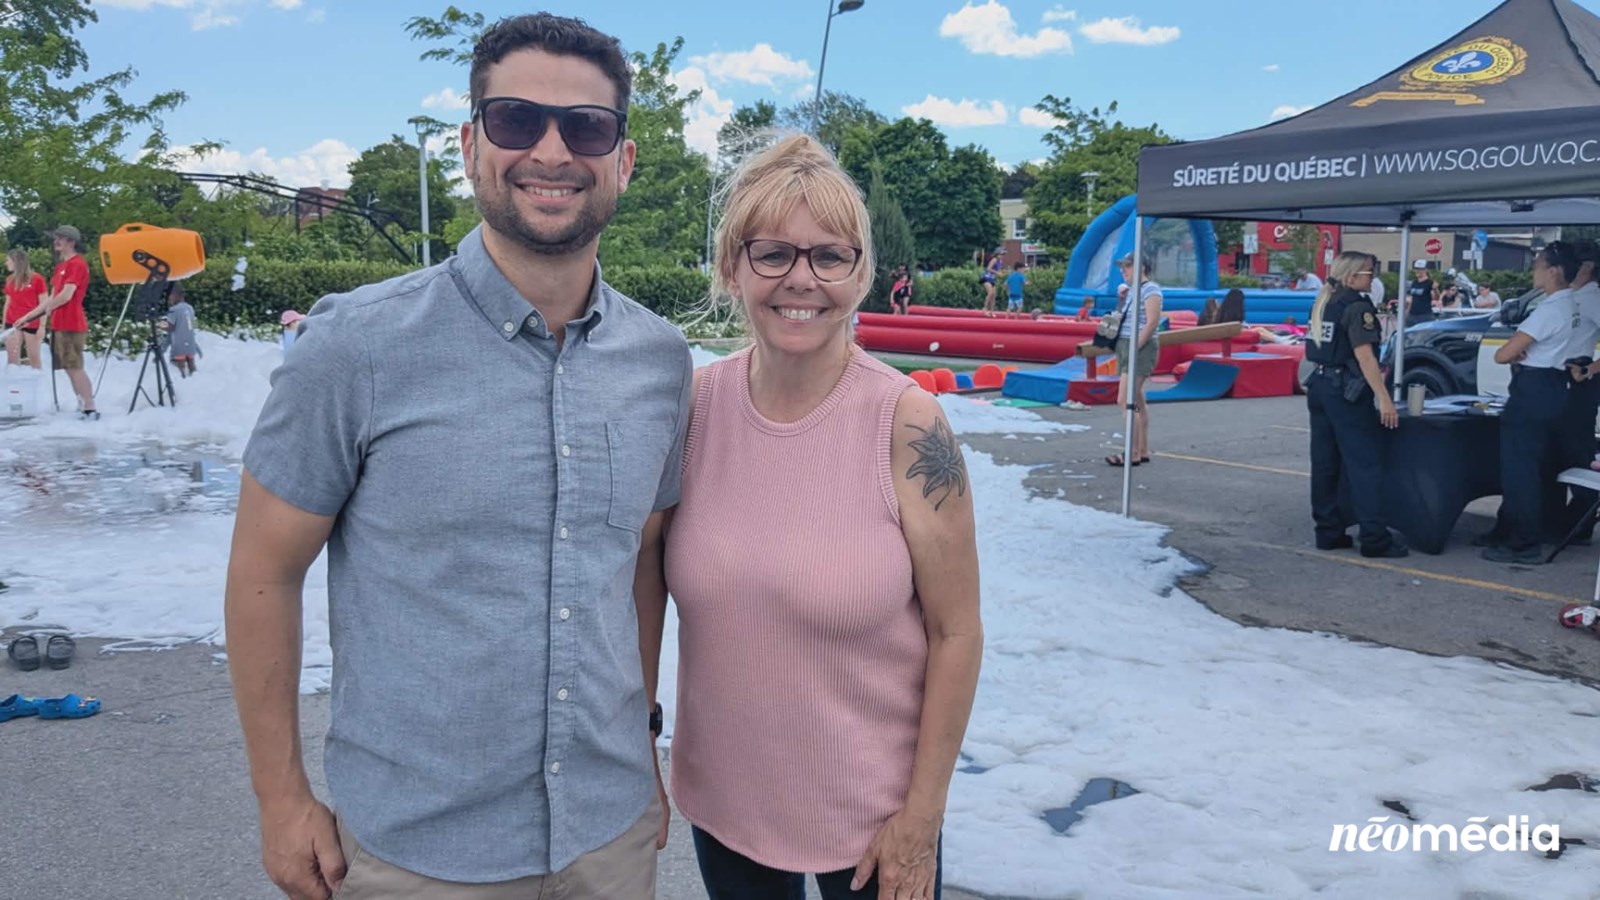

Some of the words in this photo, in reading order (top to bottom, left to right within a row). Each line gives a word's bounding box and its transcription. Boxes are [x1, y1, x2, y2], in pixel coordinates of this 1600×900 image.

[1172, 162, 1240, 188] SÛRETÉ
[1242, 164, 1270, 184] DU
[1274, 156, 1357, 184] QUÉBEC
